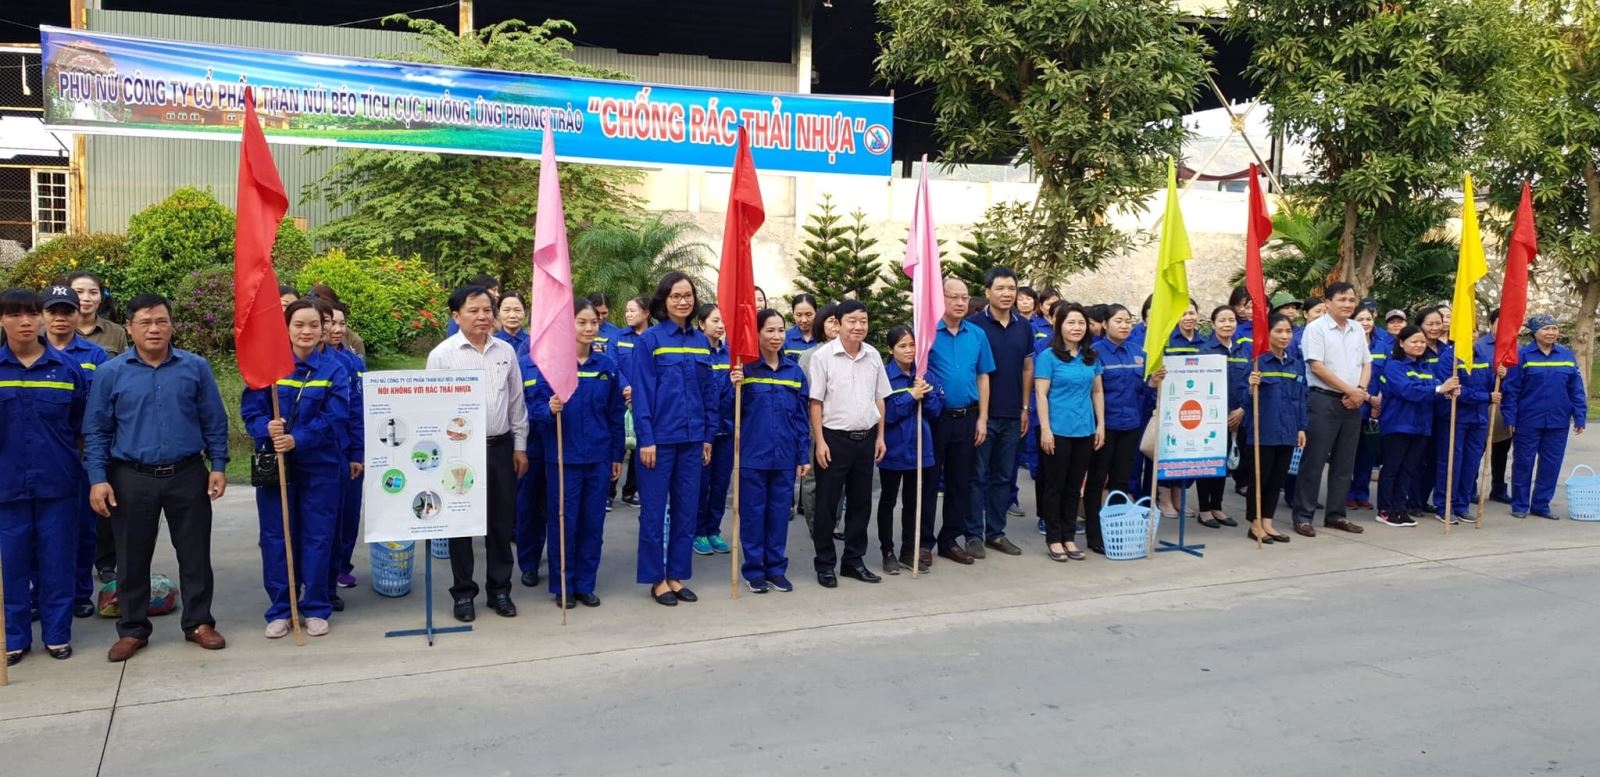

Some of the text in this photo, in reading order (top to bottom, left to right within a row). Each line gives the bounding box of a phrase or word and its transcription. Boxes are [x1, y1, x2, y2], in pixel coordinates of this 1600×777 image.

[96, 70, 119, 101] NỮ
[123, 71, 166, 105] CÔNG
[170, 81, 188, 105] TY
[193, 68, 214, 107] CỔ
[262, 86, 299, 112] THAN
[303, 83, 327, 113] NÚI
[331, 86, 357, 115] BÉO
[360, 88, 390, 117] TÍCH
[394, 94, 421, 127] CỰC
[425, 90, 470, 123] HƯỞNG
[475, 95, 502, 126] ỨNG
[506, 105, 547, 129] PHONG
[551, 103, 583, 132] TRÀO
[691, 99, 736, 145] RÁC
[741, 99, 790, 148] THẢI
[391, 385, 412, 394] KHÔNG
[425, 384, 438, 393] RÁC
